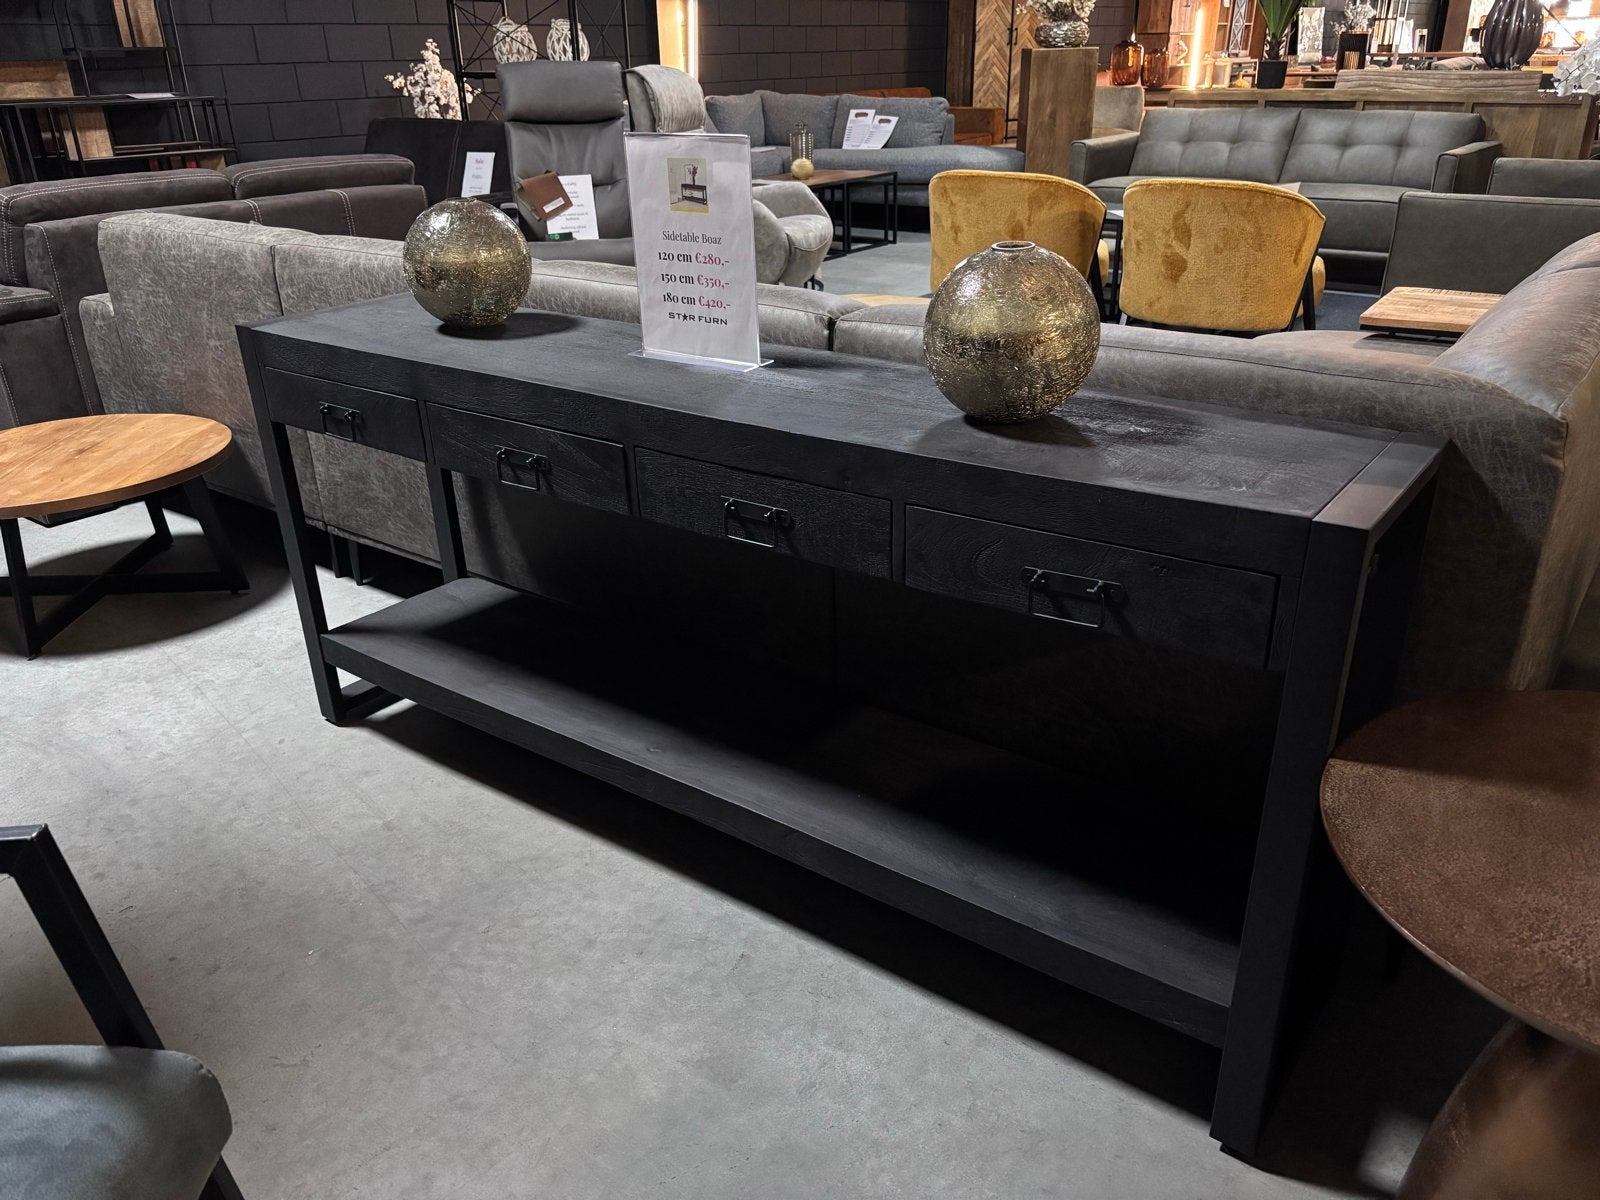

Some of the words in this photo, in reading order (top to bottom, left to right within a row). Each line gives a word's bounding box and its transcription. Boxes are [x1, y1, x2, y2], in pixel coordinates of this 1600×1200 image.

[662, 230, 700, 243] Sidetable
[701, 233, 722, 245] Boaz
[658, 251, 675, 261] 120
[676, 253, 692, 263] cm
[661, 273, 677, 284] 150
[679, 274, 694, 285] cm
[662, 291, 679, 303] 180
[681, 295, 696, 306] cm
[698, 315, 728, 326] FURN
